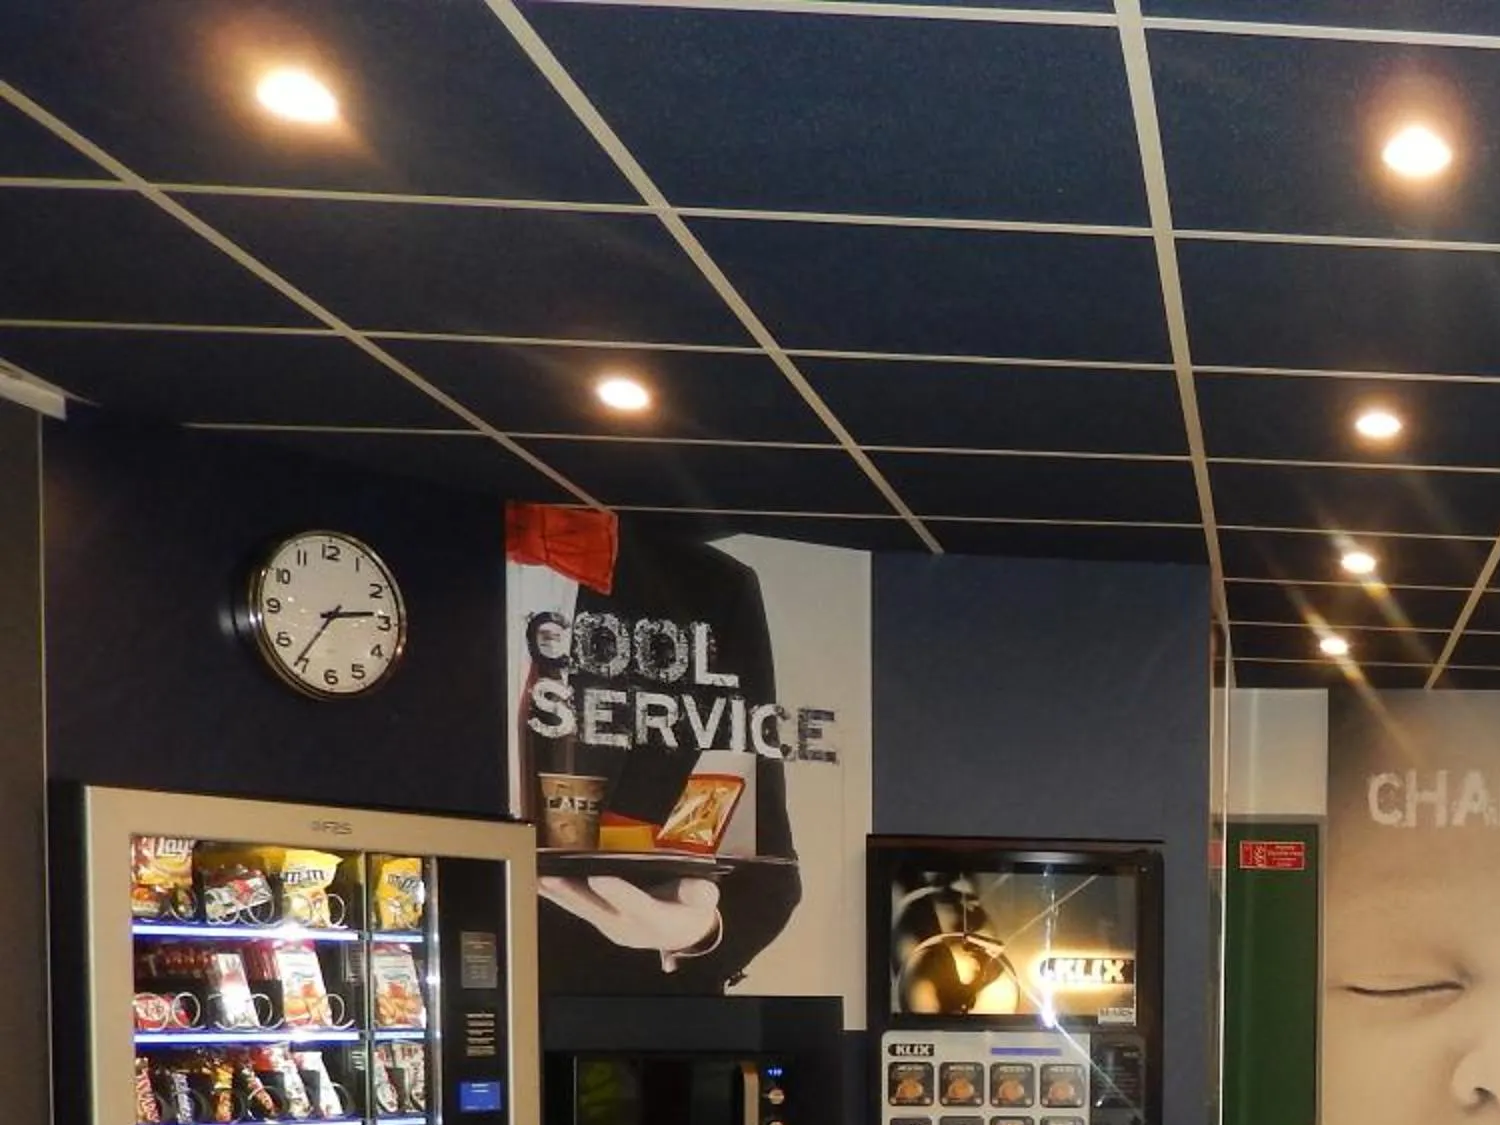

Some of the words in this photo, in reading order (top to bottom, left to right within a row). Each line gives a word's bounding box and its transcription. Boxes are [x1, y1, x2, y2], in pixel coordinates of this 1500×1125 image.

[297, 549, 308, 566] 11
[321, 543, 342, 562] 12
[354, 556, 360, 573] 1
[275, 568, 291, 585] 10
[368, 583, 384, 600] 2
[266, 598, 281, 614] 9
[376, 615, 392, 632] 3
[275, 631, 292, 648] 8
[370, 643, 384, 660] 4
[526, 610, 741, 690] COOL
[299, 656, 311, 674] 7
[351, 664, 366, 680] 5
[322, 669, 339, 685] 6
[527, 676, 840, 766] SERVICE
[1054, 957, 1126, 984] KLIX
[896, 1044, 930, 1057] KLIX
